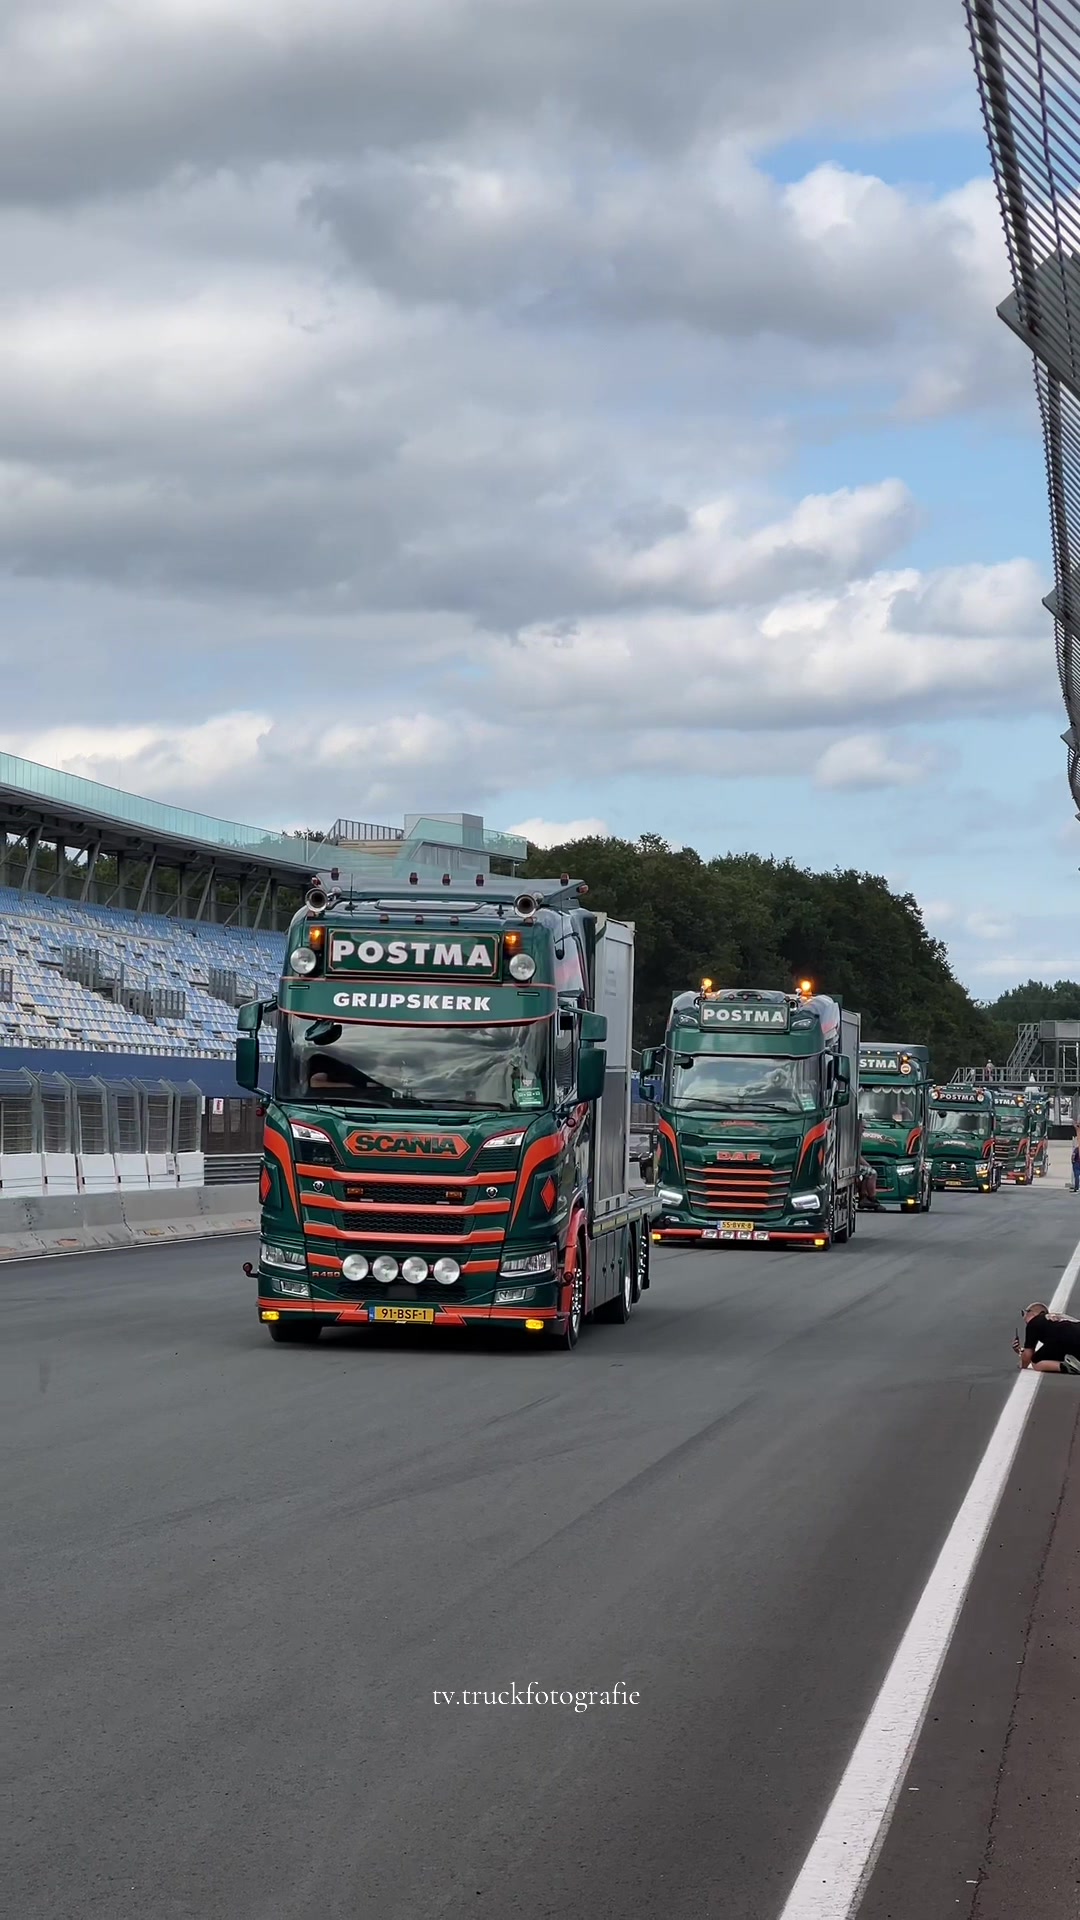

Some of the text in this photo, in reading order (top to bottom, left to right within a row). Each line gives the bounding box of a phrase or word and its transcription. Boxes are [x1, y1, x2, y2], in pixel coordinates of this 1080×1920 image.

[332, 940, 492, 967] POSTMA
[333, 992, 491, 1011] GRIJPSKERK
[703, 1008, 784, 1022] POSTMA
[859, 1058, 897, 1069] STMA
[939, 1093, 975, 1101] POSTMA
[355, 1135, 459, 1154] SCANIA
[717, 1151, 760, 1161] DAF
[381, 1308, 427, 1320] 91-BSF-1
